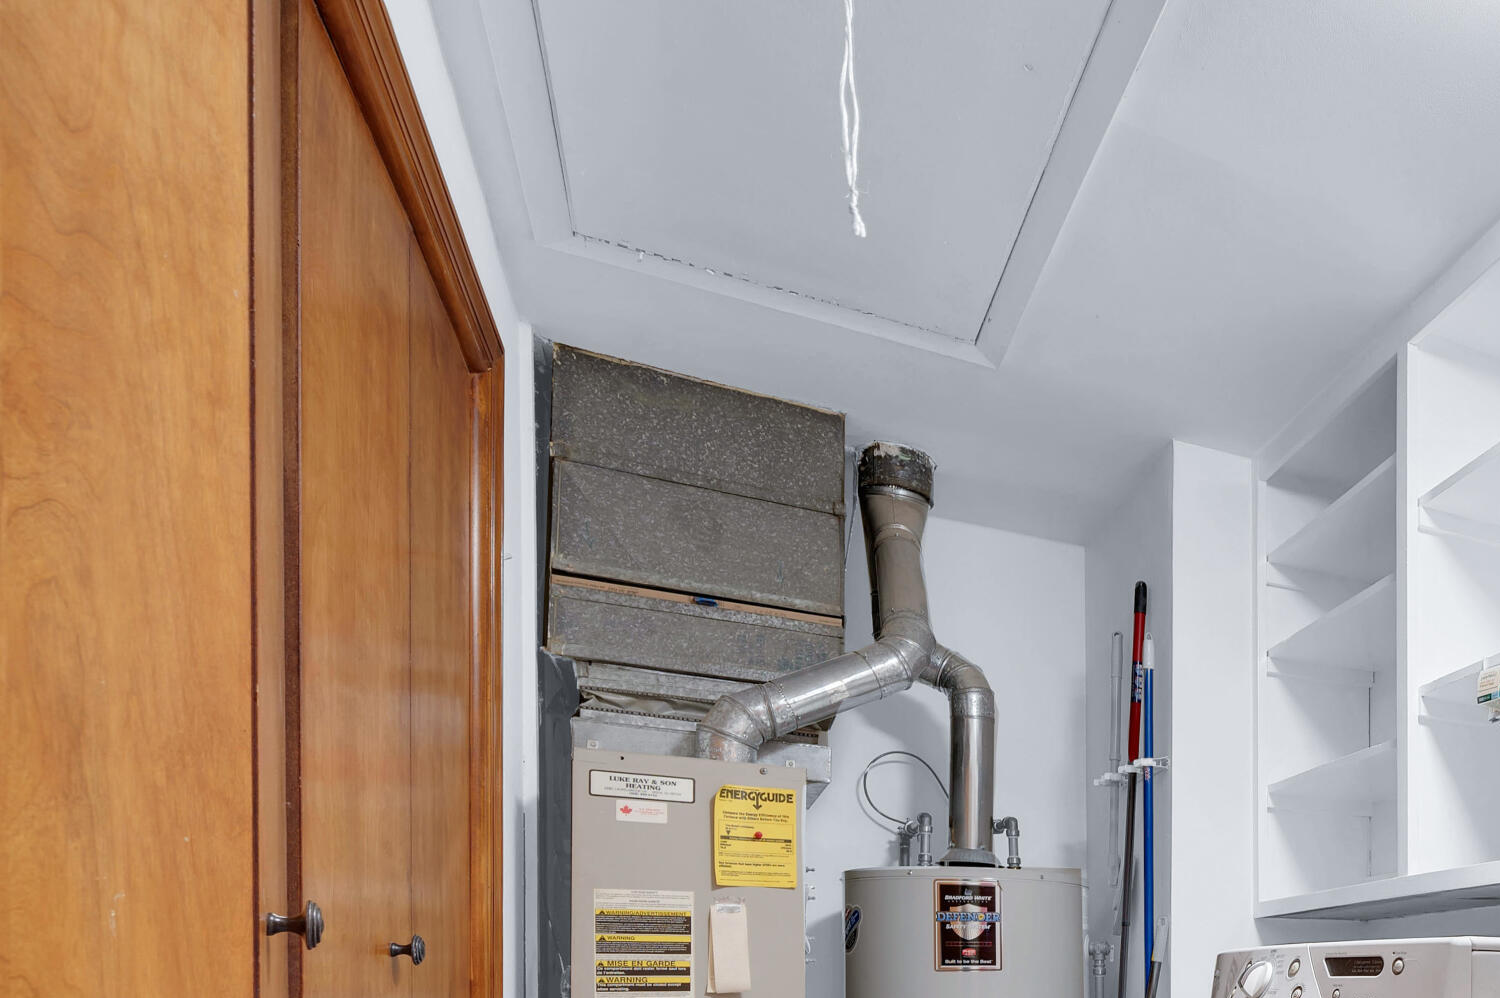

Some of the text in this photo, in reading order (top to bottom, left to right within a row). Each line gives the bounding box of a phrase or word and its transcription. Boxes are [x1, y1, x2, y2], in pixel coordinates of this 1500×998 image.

[609, 775, 631, 783] LUKE
[625, 782, 661, 791] HEATING
[719, 788, 794, 804] ENERGYGUIDE
[935, 911, 1001, 922] DEFENDER
